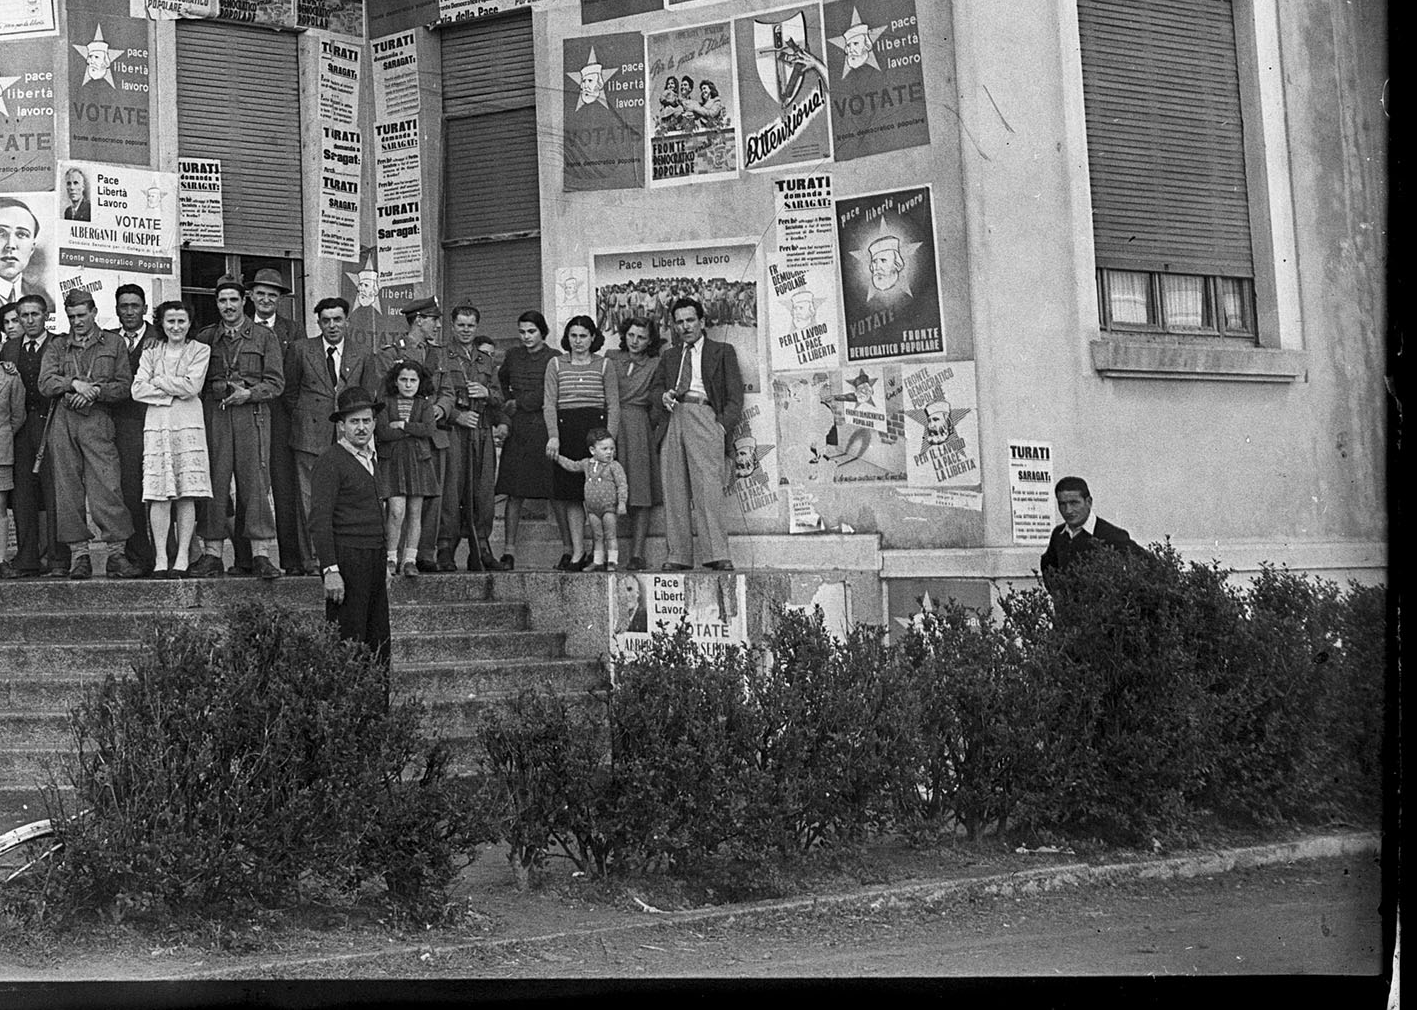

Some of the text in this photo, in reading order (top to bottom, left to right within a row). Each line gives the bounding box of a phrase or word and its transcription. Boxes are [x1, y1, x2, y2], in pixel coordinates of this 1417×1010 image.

[891, 16, 916, 31] pace
[372, 34, 414, 53] TURATI
[877, 34, 919, 52] libertà
[383, 55, 416, 70] SARAGAT:
[888, 53, 920, 67] lavoro
[25, 71, 53, 84] pace
[7, 87, 54, 100] libertà
[834, 84, 923, 115] VOTATE
[16, 105, 53, 116] lavoro
[181, 182, 219, 190] SARAGAT:
[775, 176, 830, 191] TURATI
[784, 191, 822, 199] domanda
[377, 202, 419, 217] TURATI
[784, 198, 831, 210] SARAGAT:
[898, 194, 923, 214] lavoro
[841, 207, 860, 228] pace
[378, 226, 420, 239] Saragat:
[851, 309, 894, 338] VOTATE
[903, 328, 939, 341] FRONTE
[850, 340, 940, 359] DEMOCRATICO POPOLARE
[1011, 447, 1050, 461] TURATI
[1018, 470, 1051, 482] SARAGAT:
[654, 577, 678, 587] Pace
